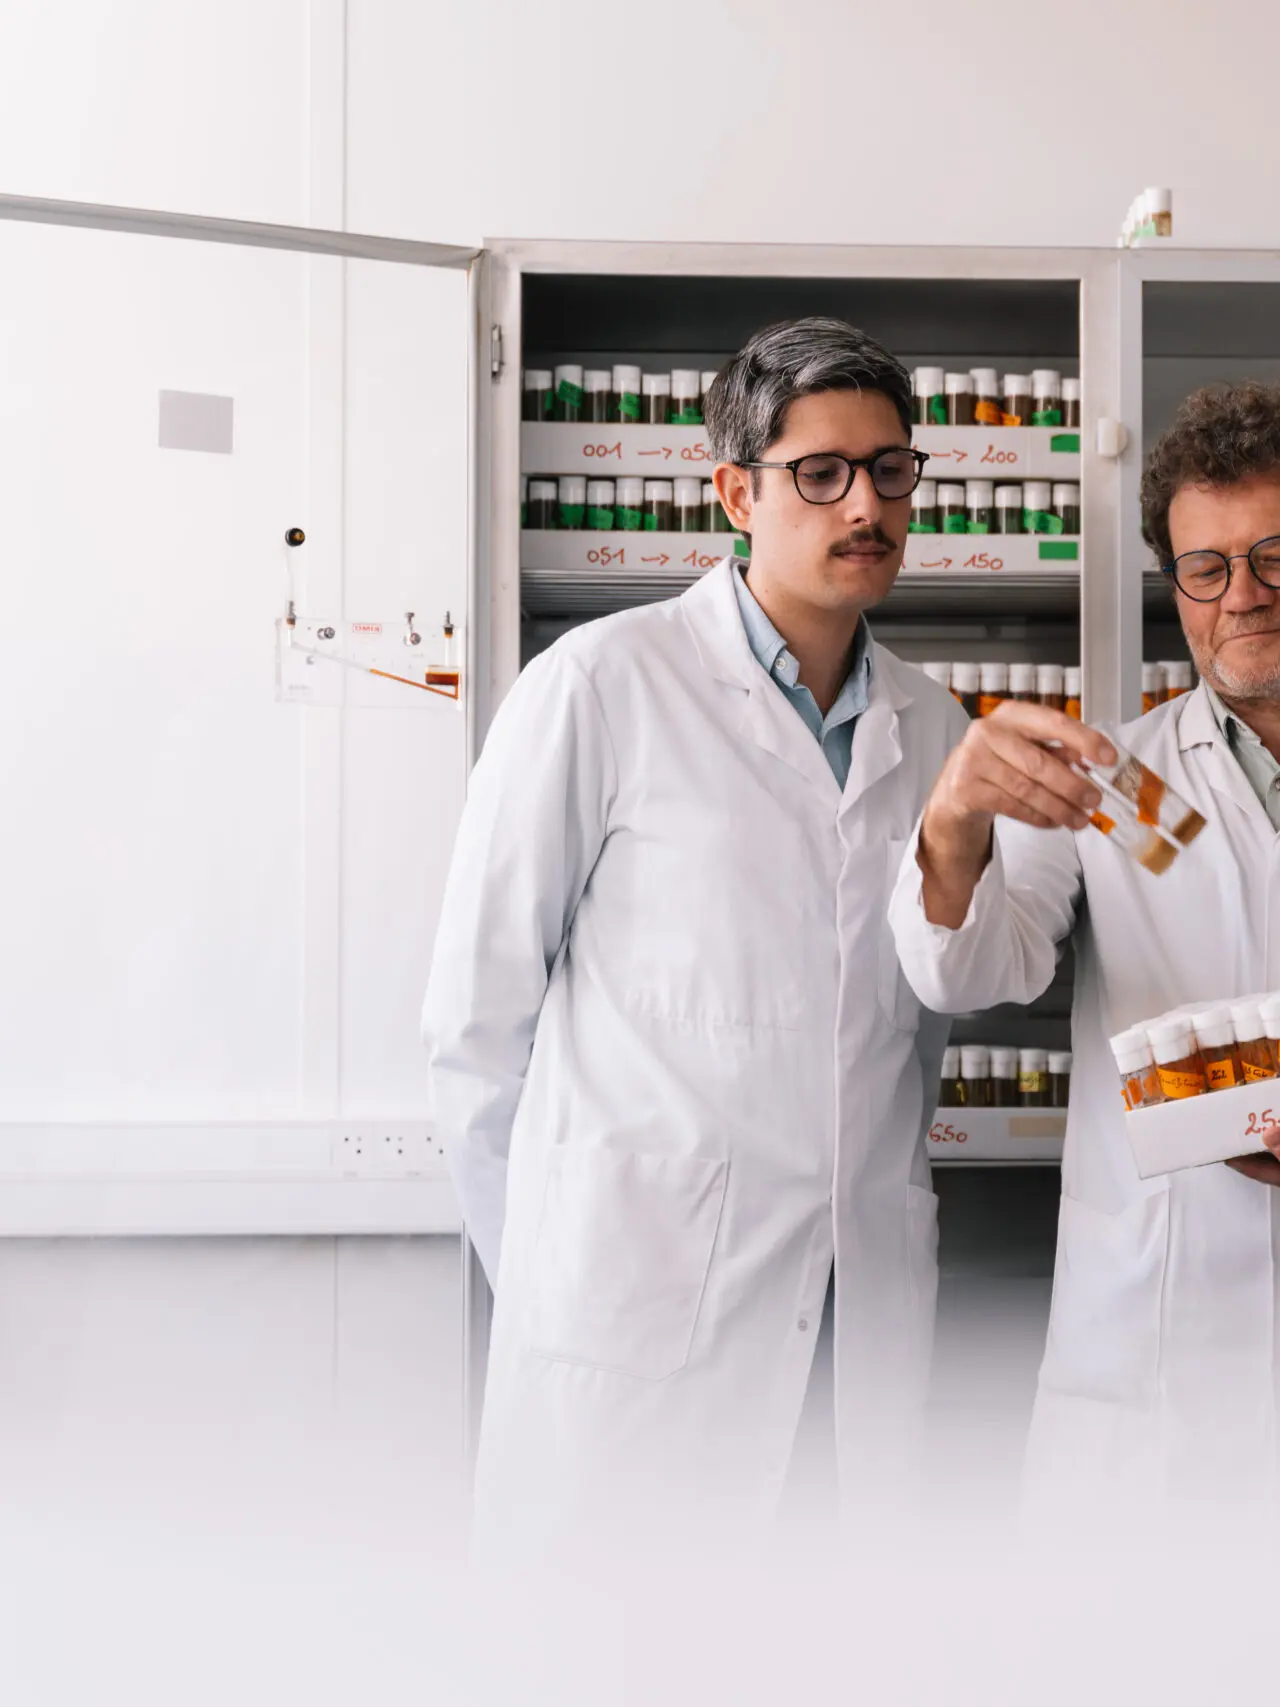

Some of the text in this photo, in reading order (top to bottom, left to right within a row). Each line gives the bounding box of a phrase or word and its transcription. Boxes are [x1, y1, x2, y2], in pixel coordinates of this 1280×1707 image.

[582, 440, 623, 460] 001
[979, 443, 1019, 464] 200
[586, 545, 626, 567] 051
[962, 552, 1004, 571] 150
[928, 1122, 969, 1144] 650
